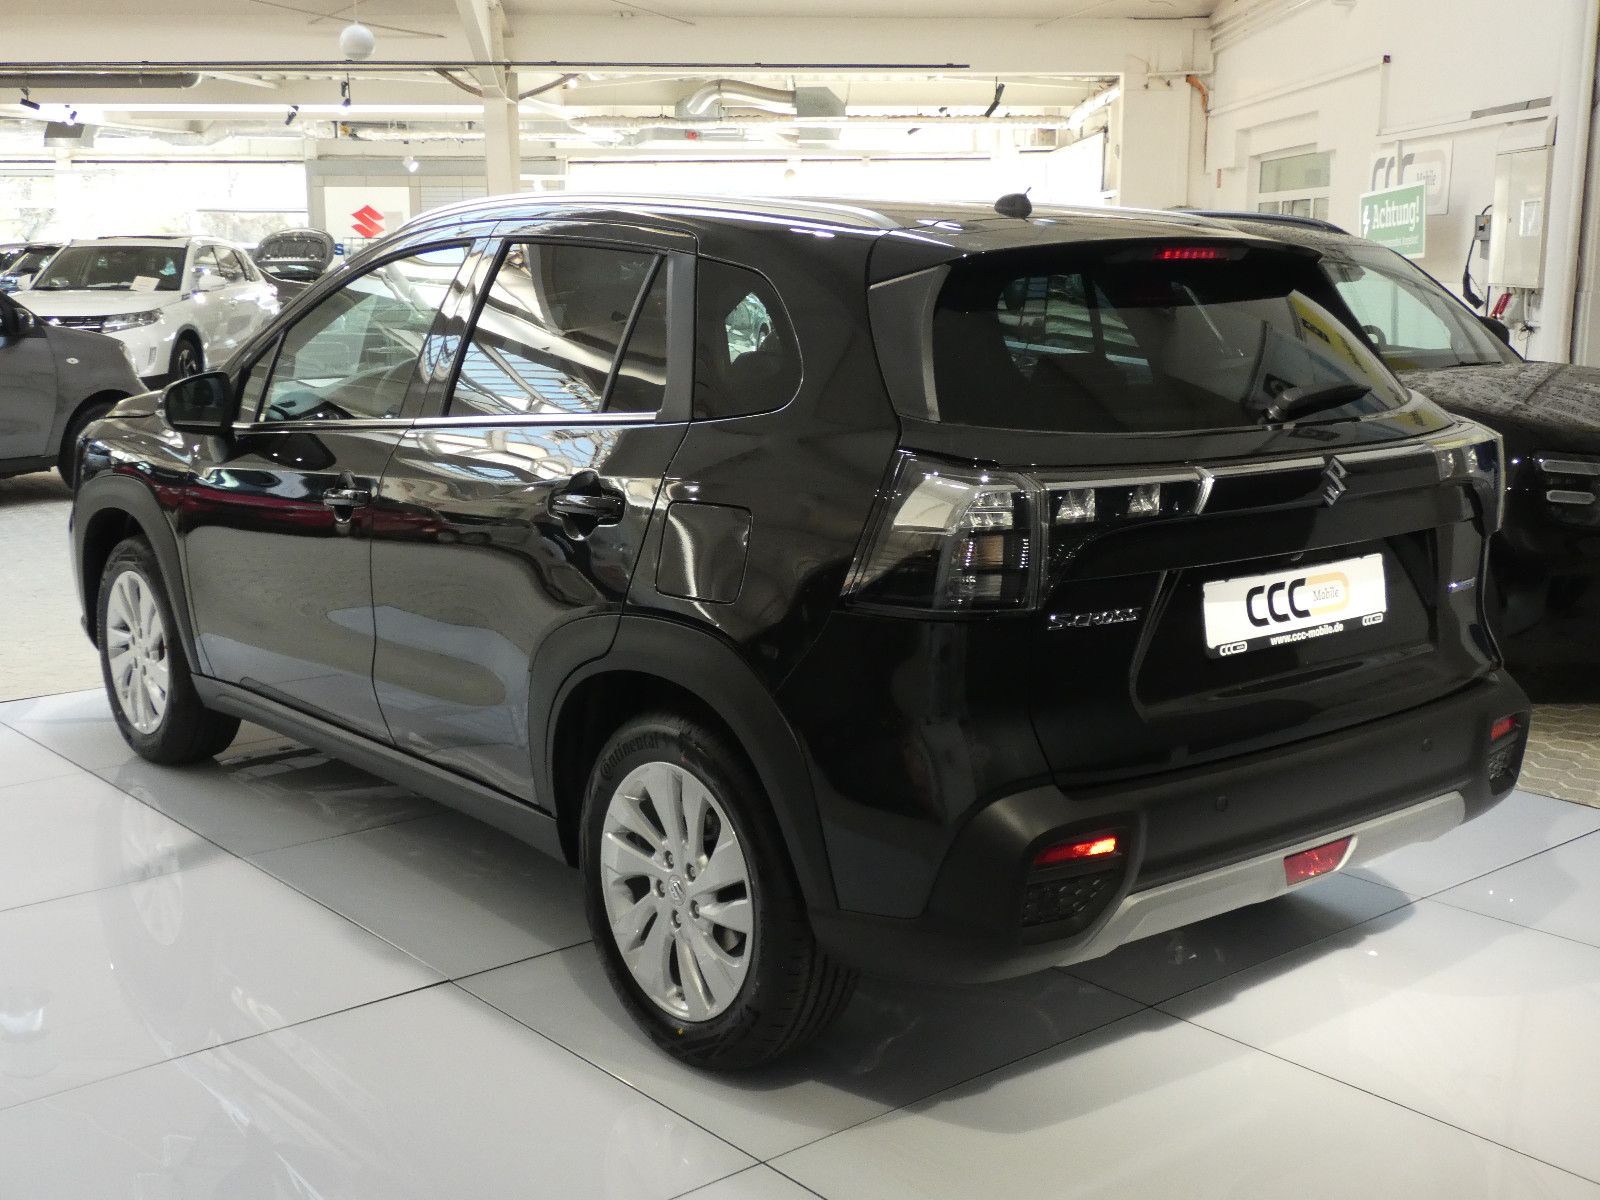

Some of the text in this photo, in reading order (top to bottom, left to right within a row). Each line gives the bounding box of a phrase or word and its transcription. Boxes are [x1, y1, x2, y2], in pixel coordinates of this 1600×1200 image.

[1372, 196, 1420, 232] Achtung!
[1246, 578, 1340, 628] CCC Mobile
[1270, 622, 1344, 646] www.ccc-mobile.de
